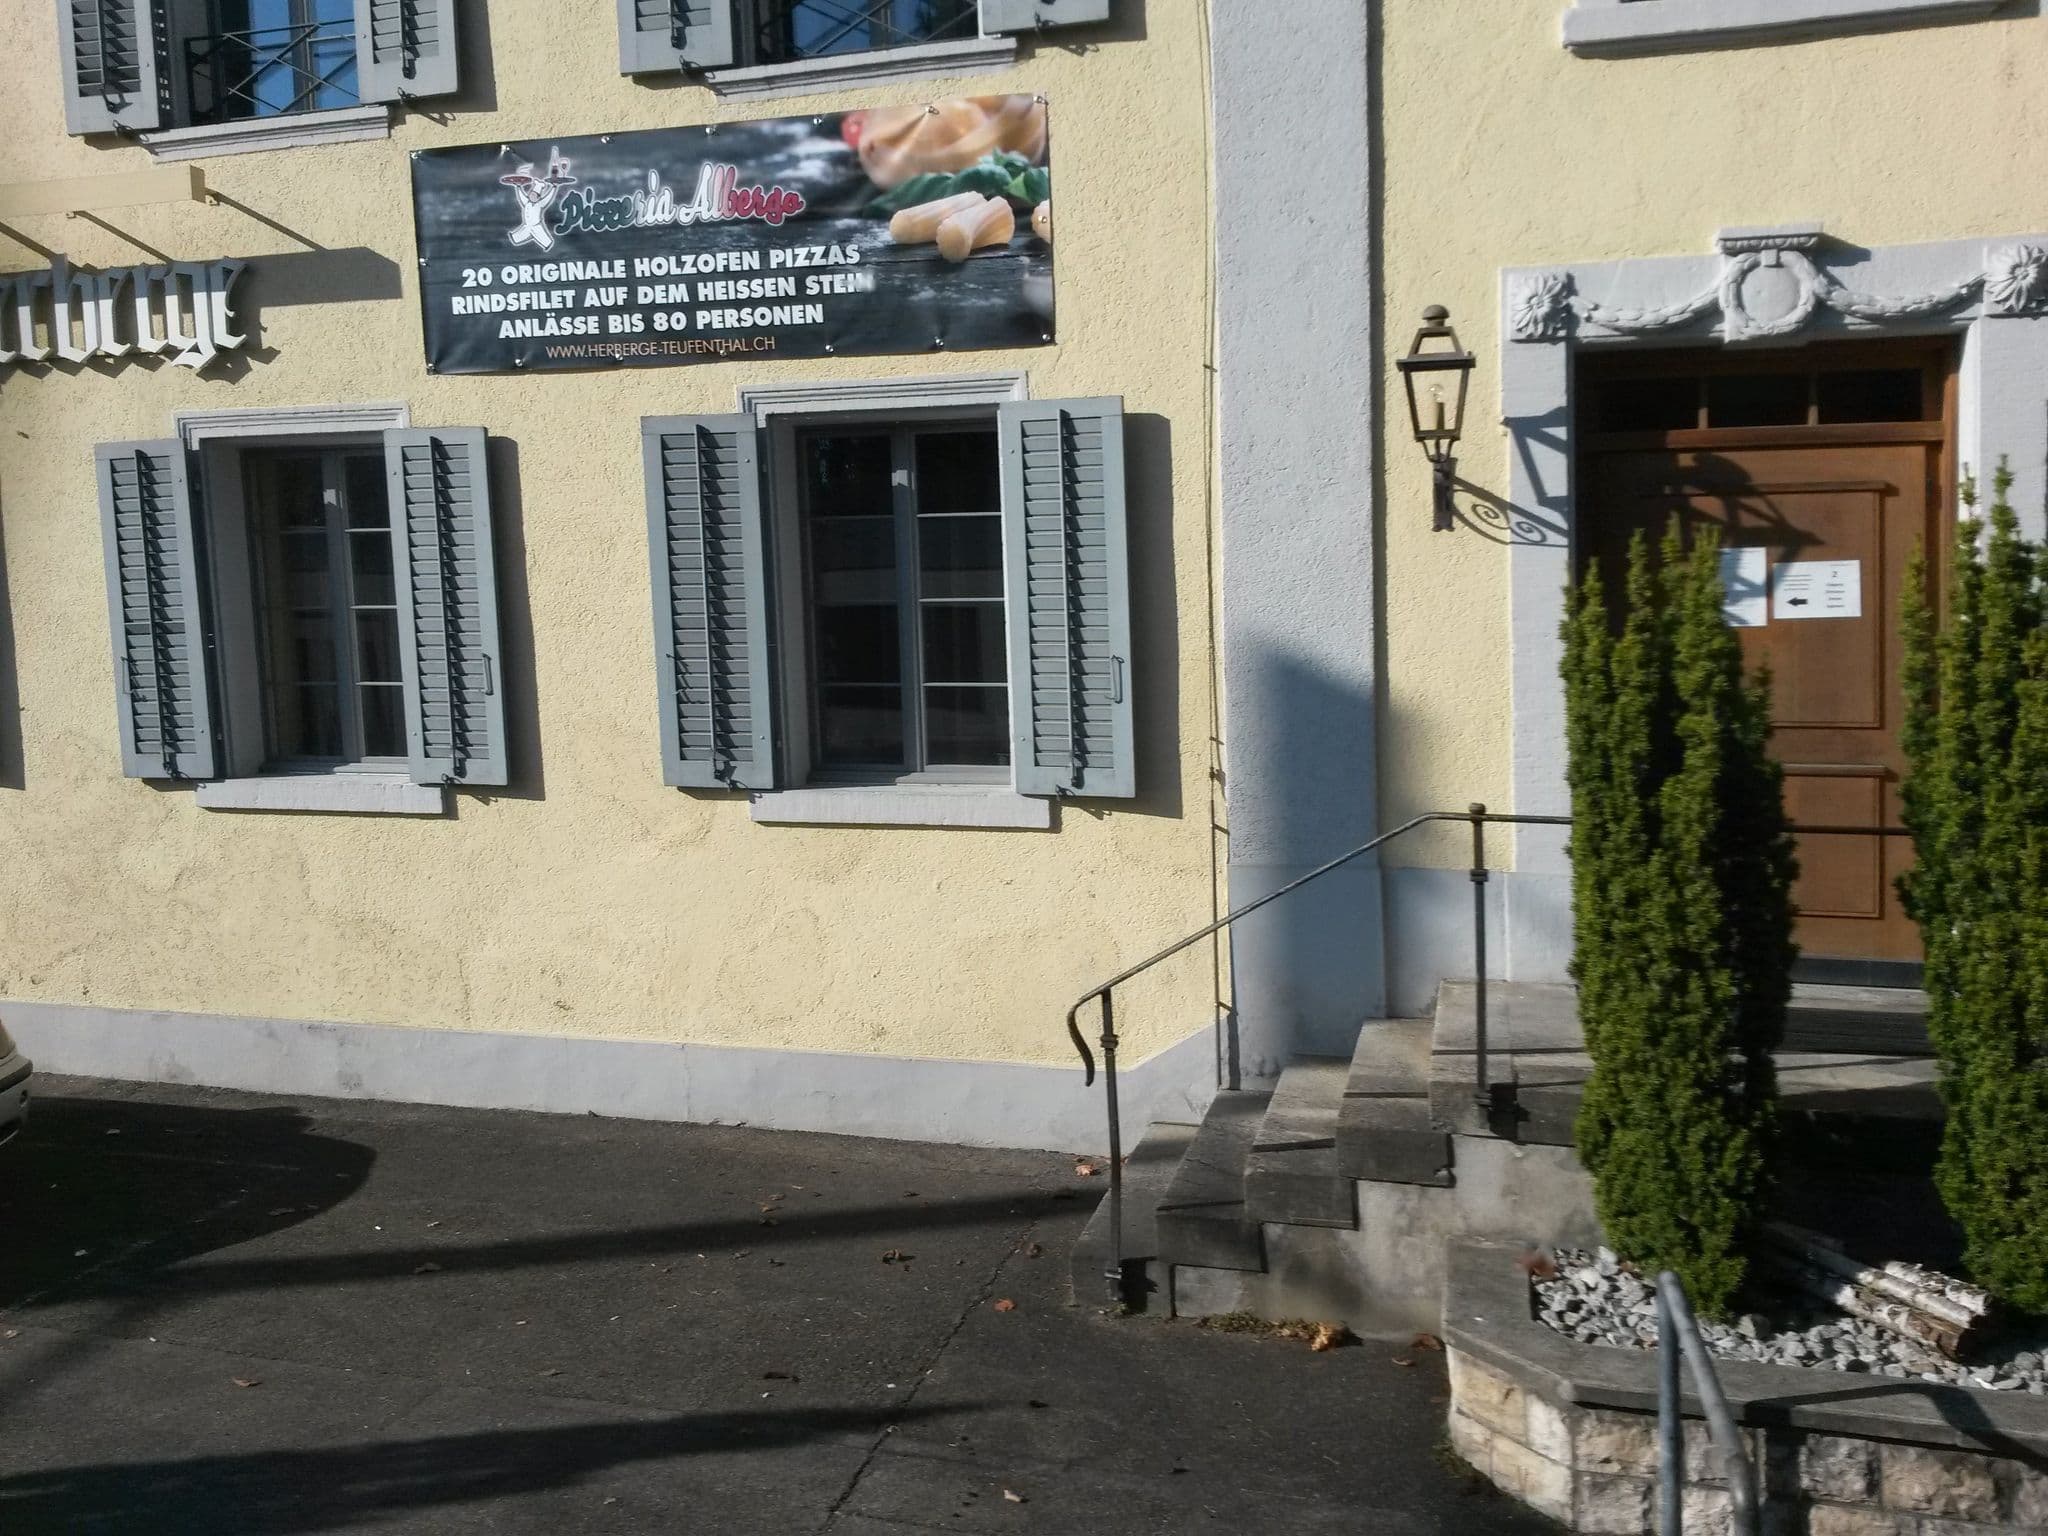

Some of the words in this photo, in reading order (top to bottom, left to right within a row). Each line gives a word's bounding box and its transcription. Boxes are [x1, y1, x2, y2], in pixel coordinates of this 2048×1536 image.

[554, 169, 676, 235] Pizzeria
[677, 162, 805, 226] Albergo
[462, 267, 492, 288] 20
[501, 259, 627, 285] ORIGINALE
[634, 250, 761, 278] HOLZOFEN
[770, 244, 861, 269] PIZZAS
[452, 289, 576, 315] RINDSFILET
[584, 286, 628, 308] AUF
[637, 283, 690, 304] DEM
[697, 276, 797, 302] HEISSEN
[499, 312, 601, 339] ANLÄSSE
[608, 313, 646, 334] BIS
[653, 311, 687, 332] 80
[696, 304, 824, 330] PERSONEN
[545, 335, 776, 359] WWW.HERBERGE-TEUFENTHAL.CH
